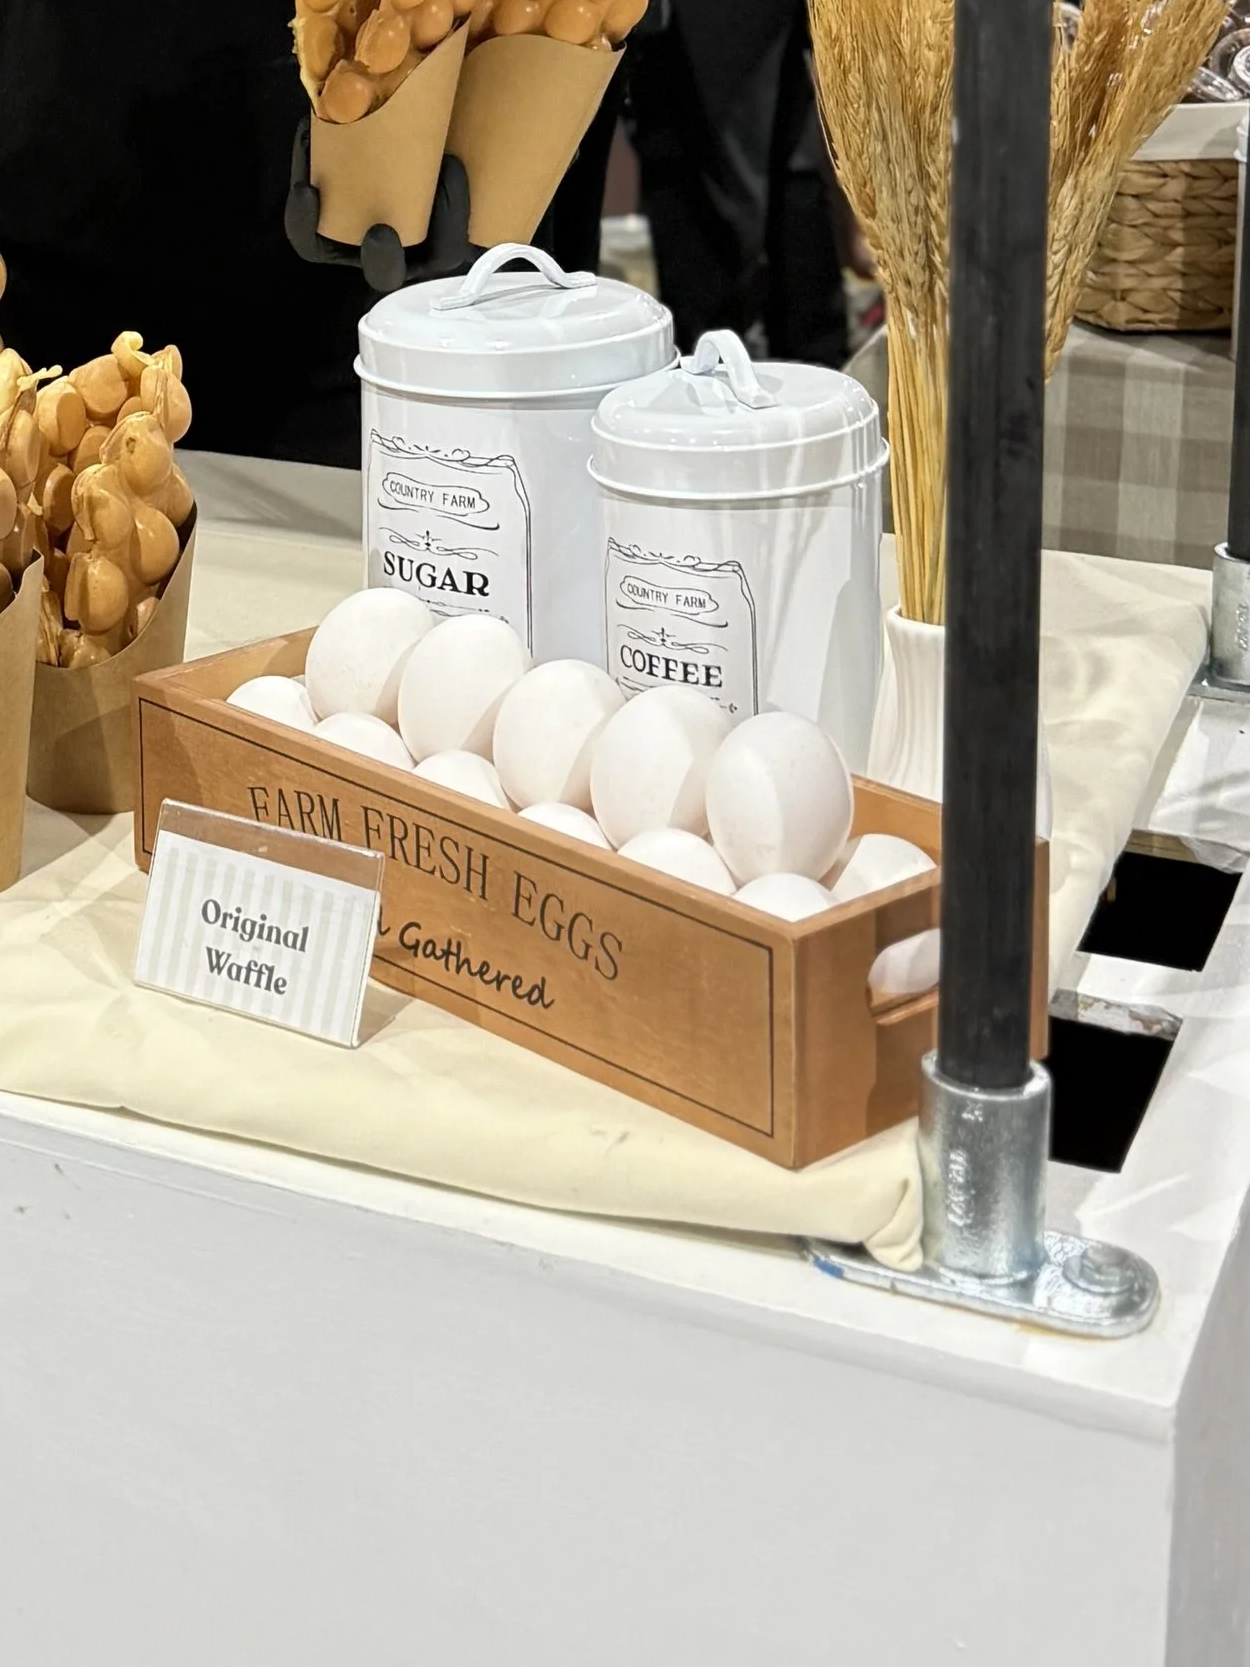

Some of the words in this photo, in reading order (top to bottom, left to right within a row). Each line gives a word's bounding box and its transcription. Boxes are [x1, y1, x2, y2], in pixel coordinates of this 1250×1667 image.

[389, 479, 435, 504] COUNTRY
[442, 492, 477, 510] FARM
[382, 550, 490, 597] SUGAR
[626, 583, 669, 605] COUNTRY
[675, 593, 707, 610] FARM
[619, 645, 723, 688] COFFEE
[247, 786, 343, 842] FARM
[360, 805, 490, 901] FRESH
[510, 870, 623, 981] EGGS
[201, 899, 309, 953] Original
[206, 946, 288, 995] Waffle
[398, 921, 555, 1010] Gathered
